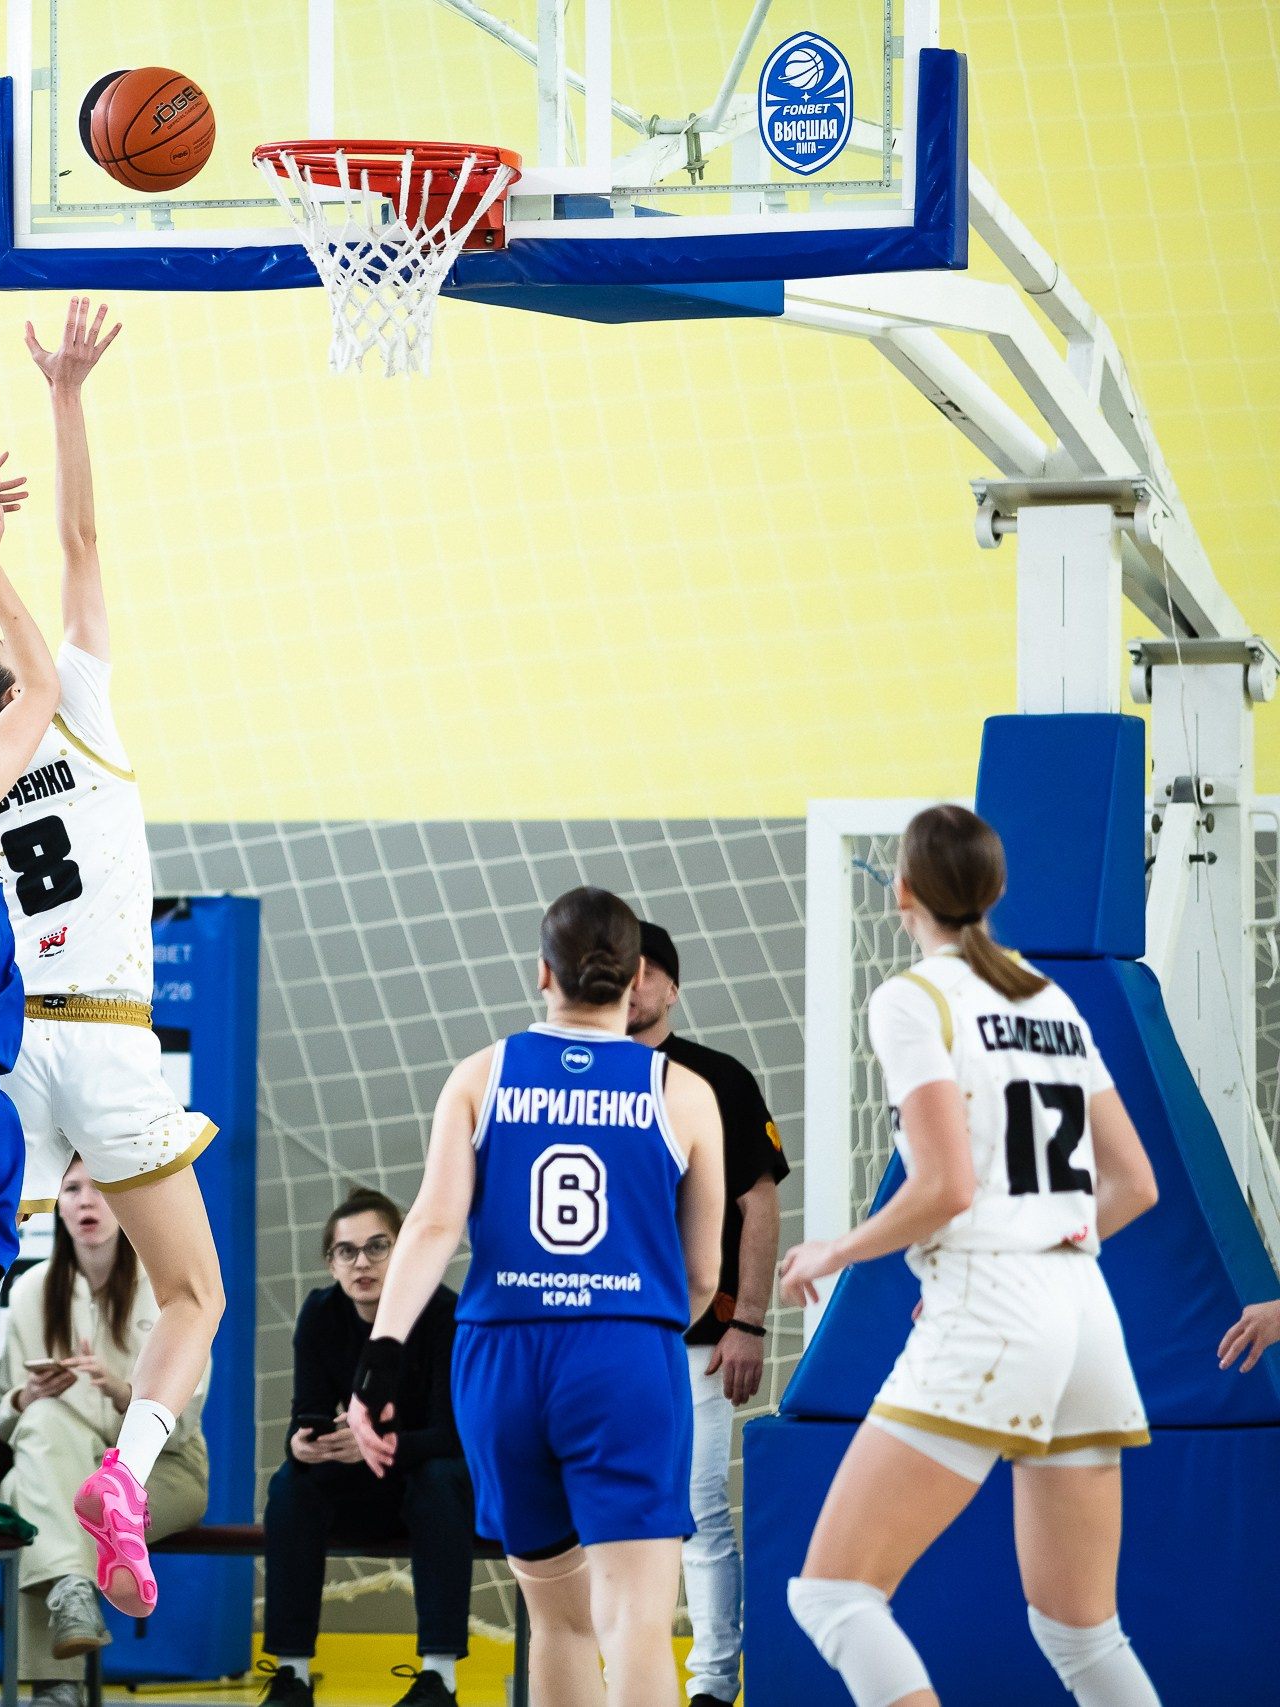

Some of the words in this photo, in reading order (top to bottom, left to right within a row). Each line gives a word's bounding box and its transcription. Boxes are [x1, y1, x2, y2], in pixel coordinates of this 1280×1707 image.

[151, 85, 202, 135] JÖGEL
[782, 103, 831, 116] FONBET
[774, 118, 838, 142] ВЫСШАЯ
[795, 142, 817, 155] ЛИГА
[0, 815, 83, 917] 8
[39, 926, 68, 954] NRJ
[565, 1053, 590, 1064] РФБ
[495, 1086, 654, 1130] КИРИЛЕНКО
[1004, 1079, 1094, 1196] 12
[529, 1143, 608, 1255] 6
[497, 1271, 641, 1292] КРАСНОЯРСКИЙ
[542, 1290, 592, 1306] КРАЙ
